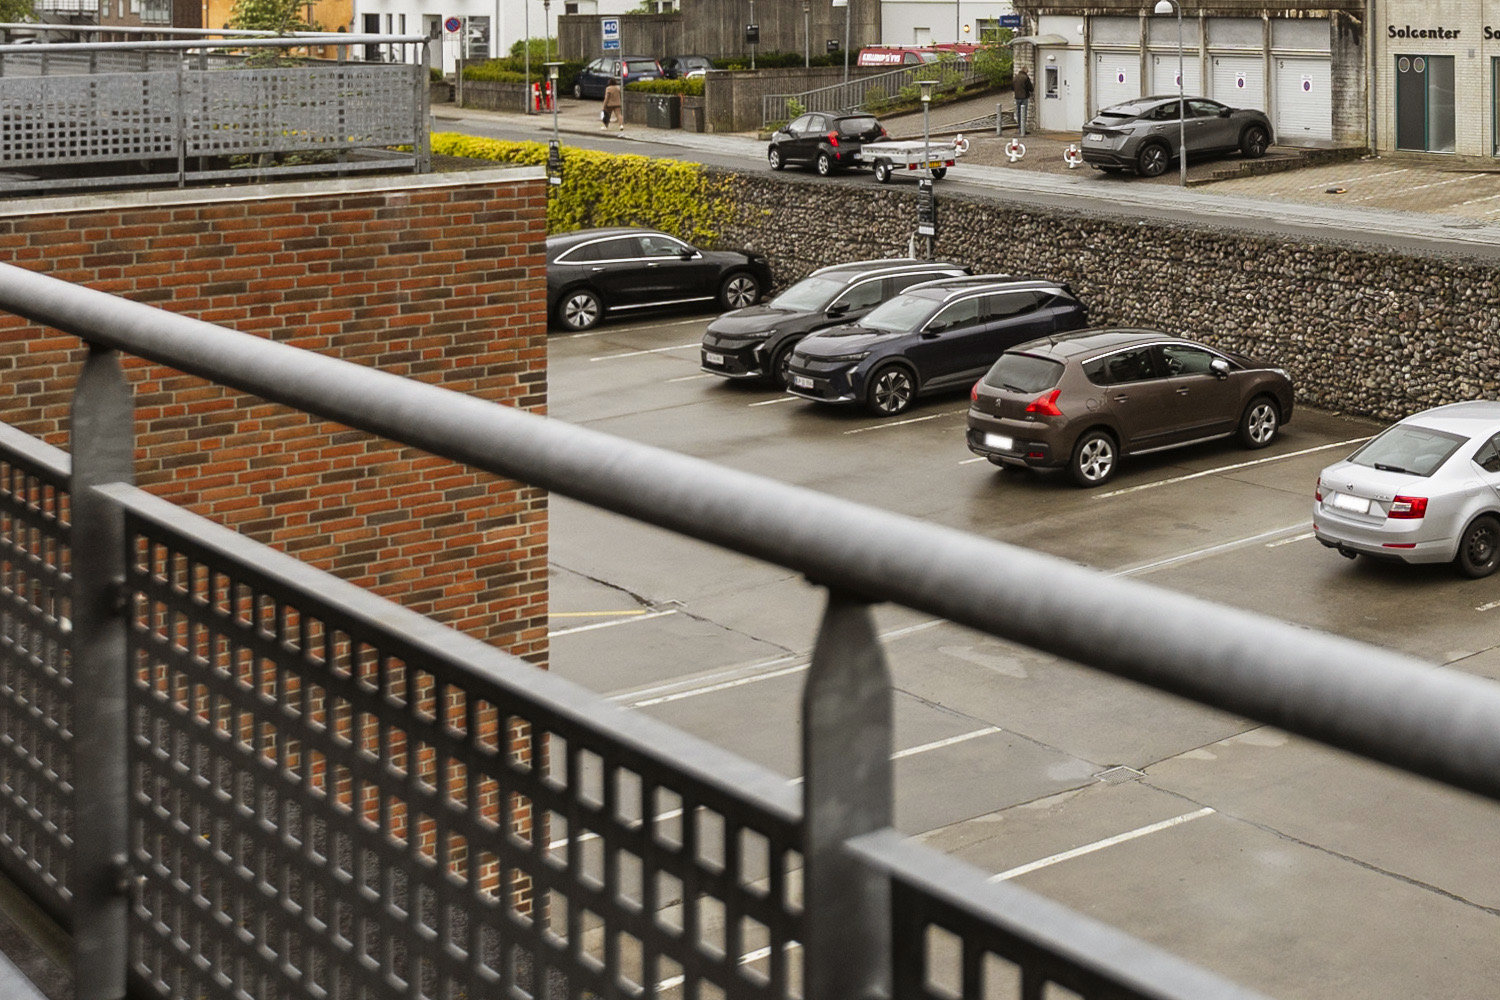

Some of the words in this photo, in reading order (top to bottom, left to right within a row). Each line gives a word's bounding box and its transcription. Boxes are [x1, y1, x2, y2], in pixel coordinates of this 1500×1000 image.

[605, 22, 617, 31] 40
[1388, 25, 1461, 39] Solcenter
[1279, 61, 1284, 69] 5
